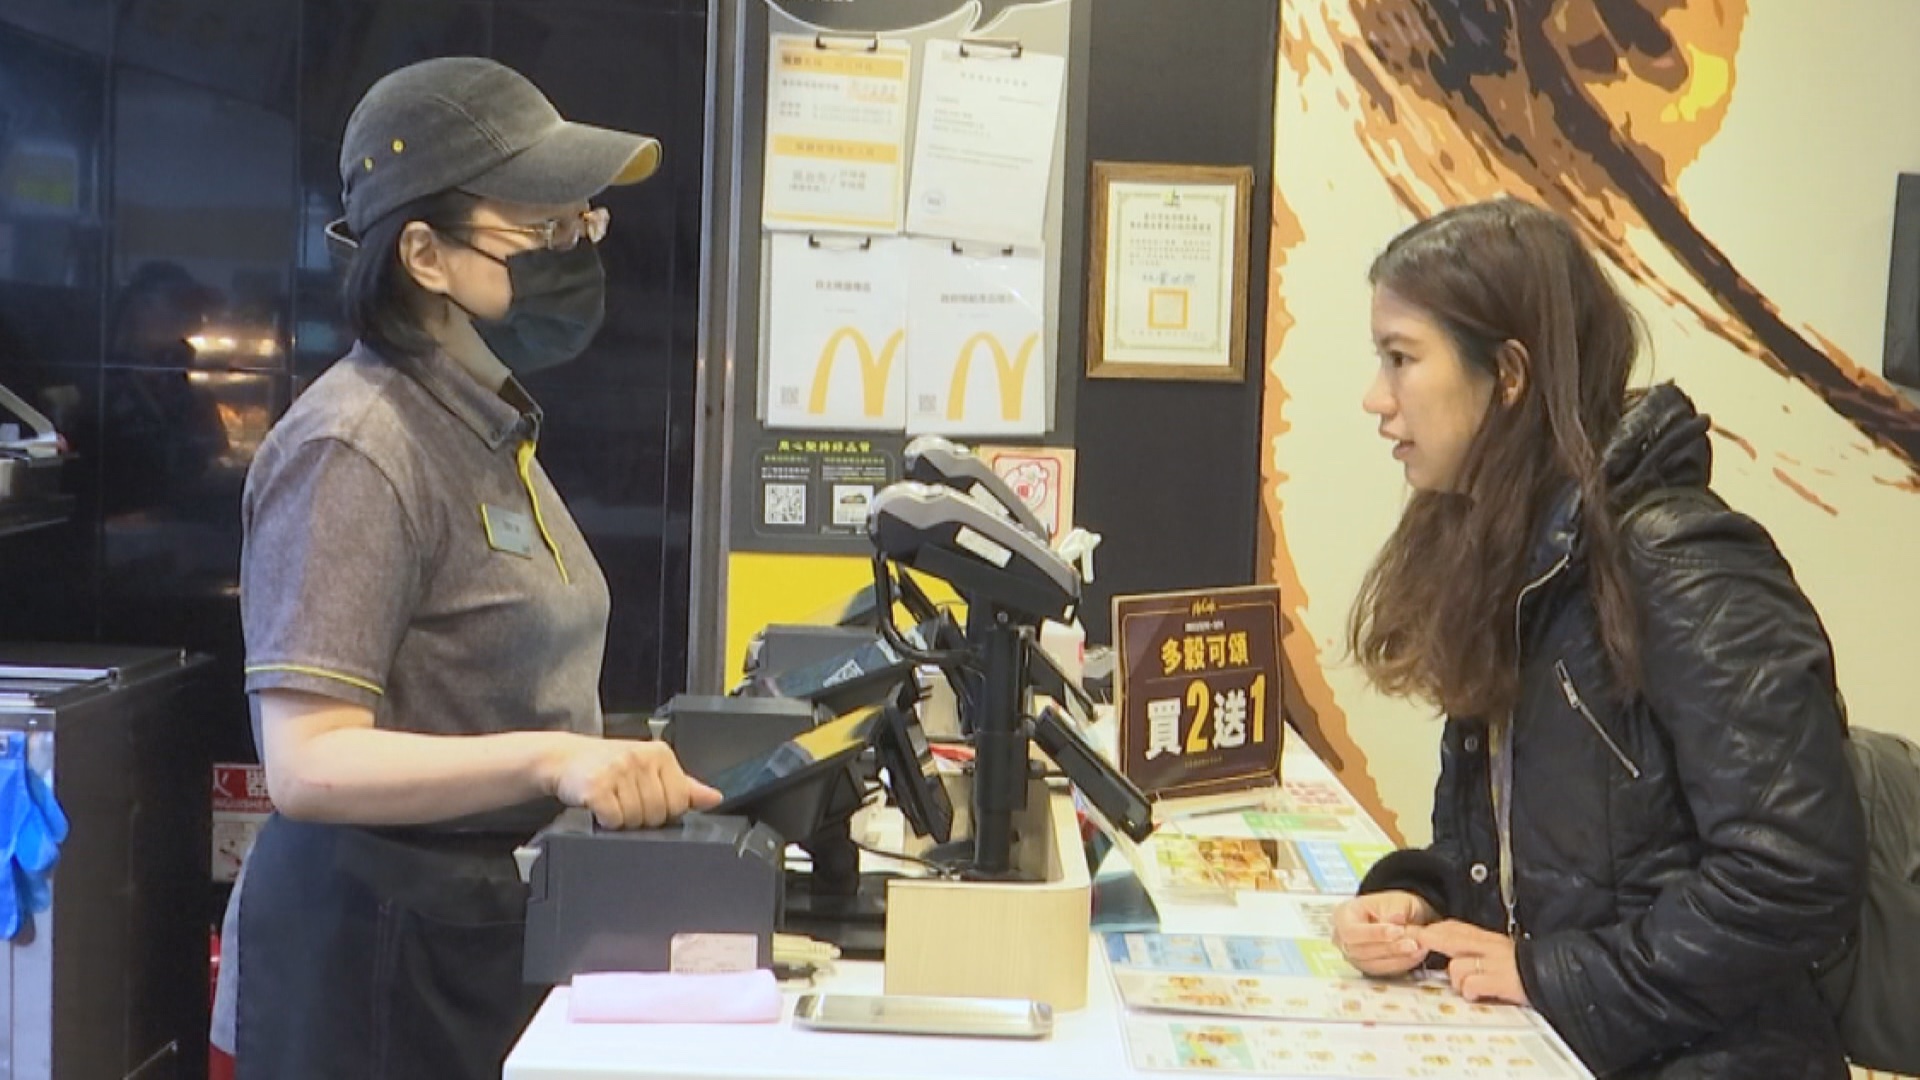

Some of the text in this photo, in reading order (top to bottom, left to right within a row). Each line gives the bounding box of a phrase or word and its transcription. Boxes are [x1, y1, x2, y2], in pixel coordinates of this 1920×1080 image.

[1161, 631, 1249, 675] 多穀可頌
[1145, 673, 1266, 760] 買2送1
